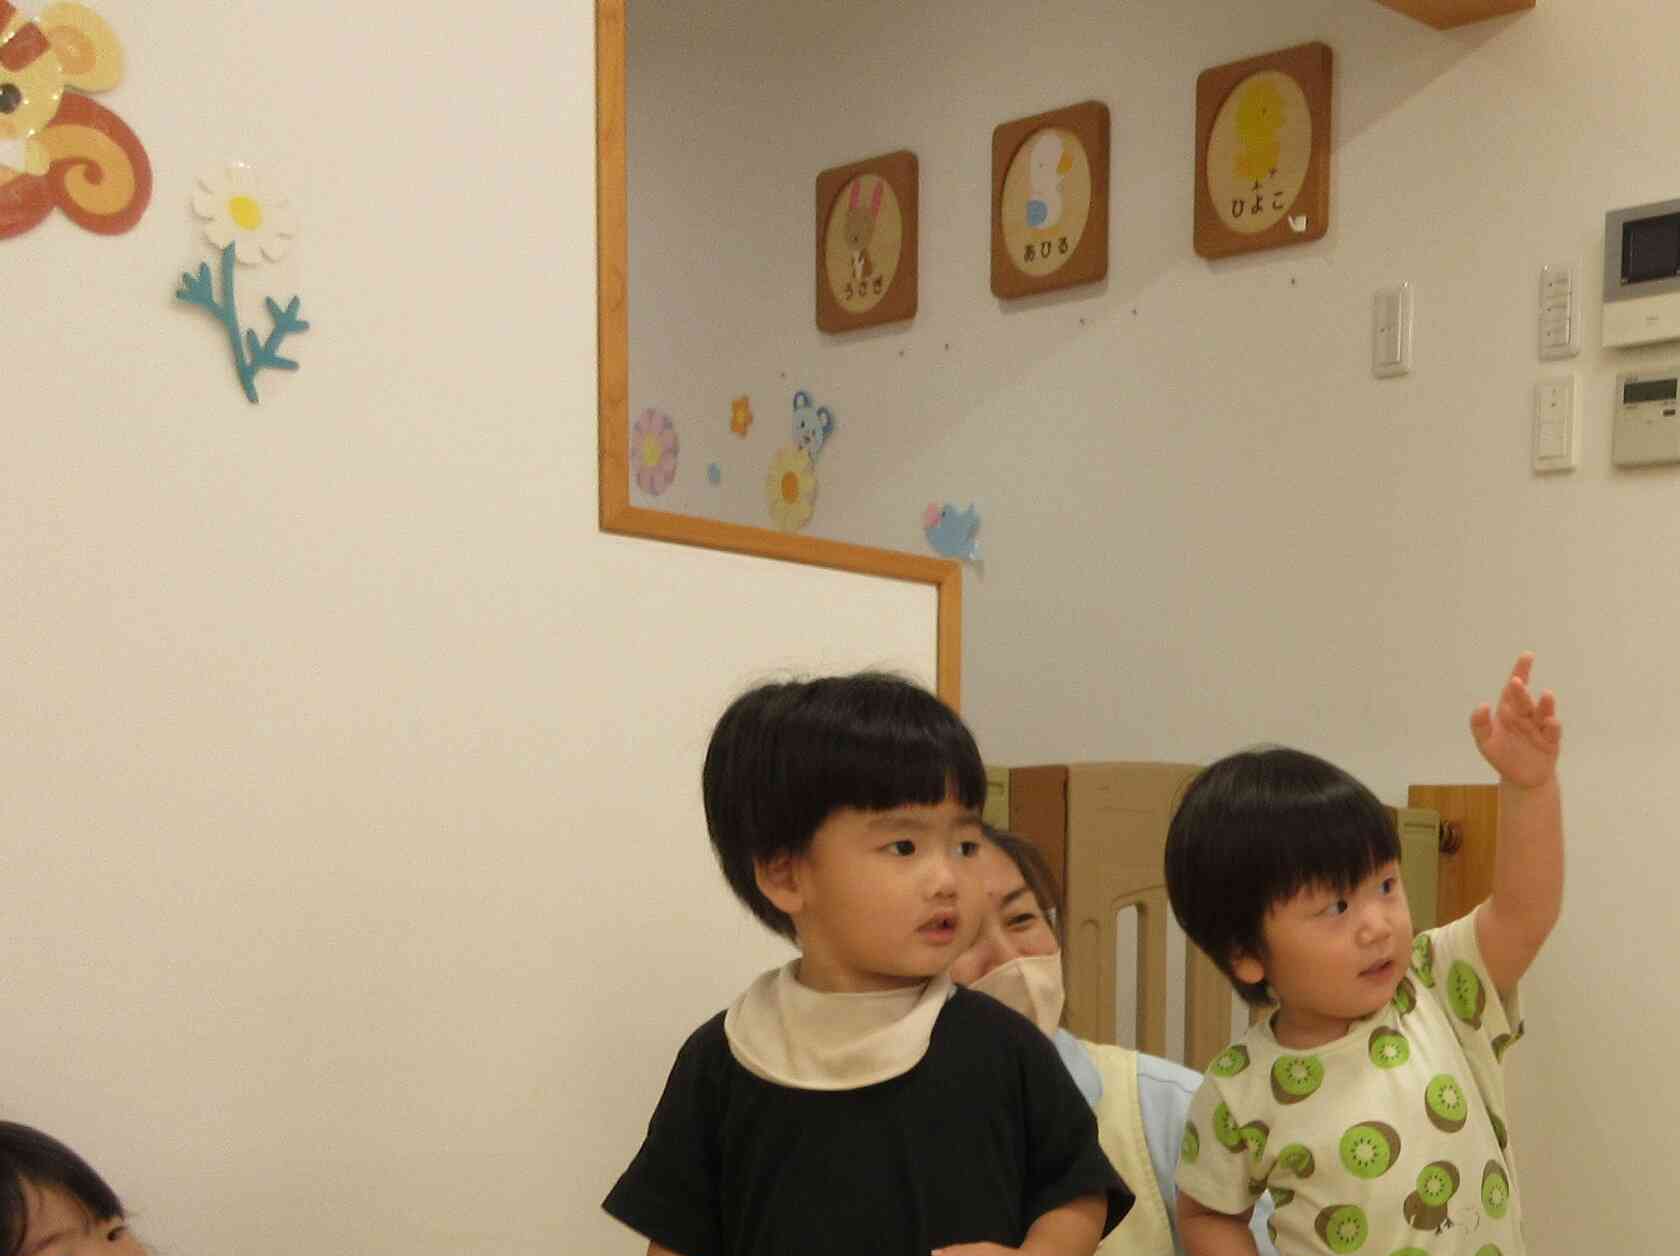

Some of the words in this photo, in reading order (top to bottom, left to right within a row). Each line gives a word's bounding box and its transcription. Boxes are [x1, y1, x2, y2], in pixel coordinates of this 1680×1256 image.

[1232, 191, 1284, 217] ひよこ
[1023, 236, 1070, 263] あひる
